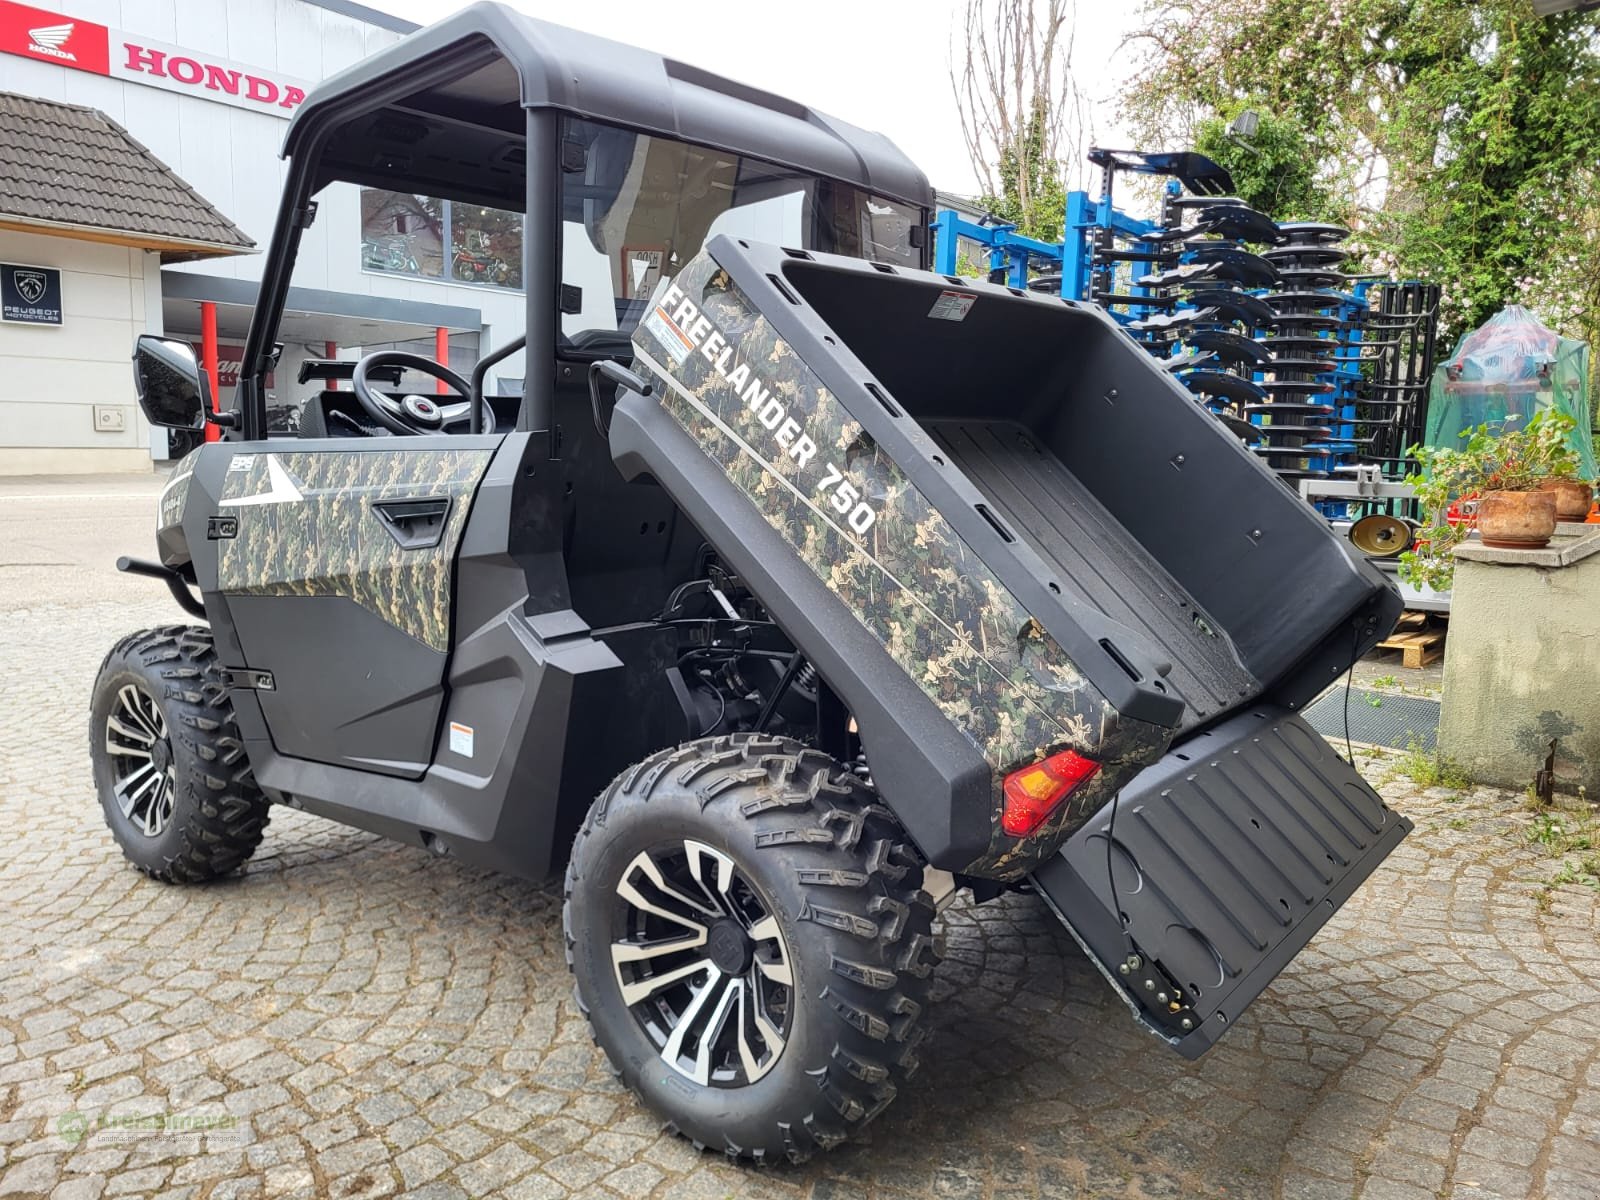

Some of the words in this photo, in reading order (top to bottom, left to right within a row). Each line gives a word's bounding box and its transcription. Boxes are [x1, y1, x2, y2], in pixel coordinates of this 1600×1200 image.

[28, 43, 77, 62] HONDA
[124, 42, 306, 109] HONDA
[4, 306, 59, 315] PEUGEOT
[5, 312, 59, 321] MOTOCYCLES
[659, 284, 817, 469] FREELANDER
[817, 462, 876, 534] 750
